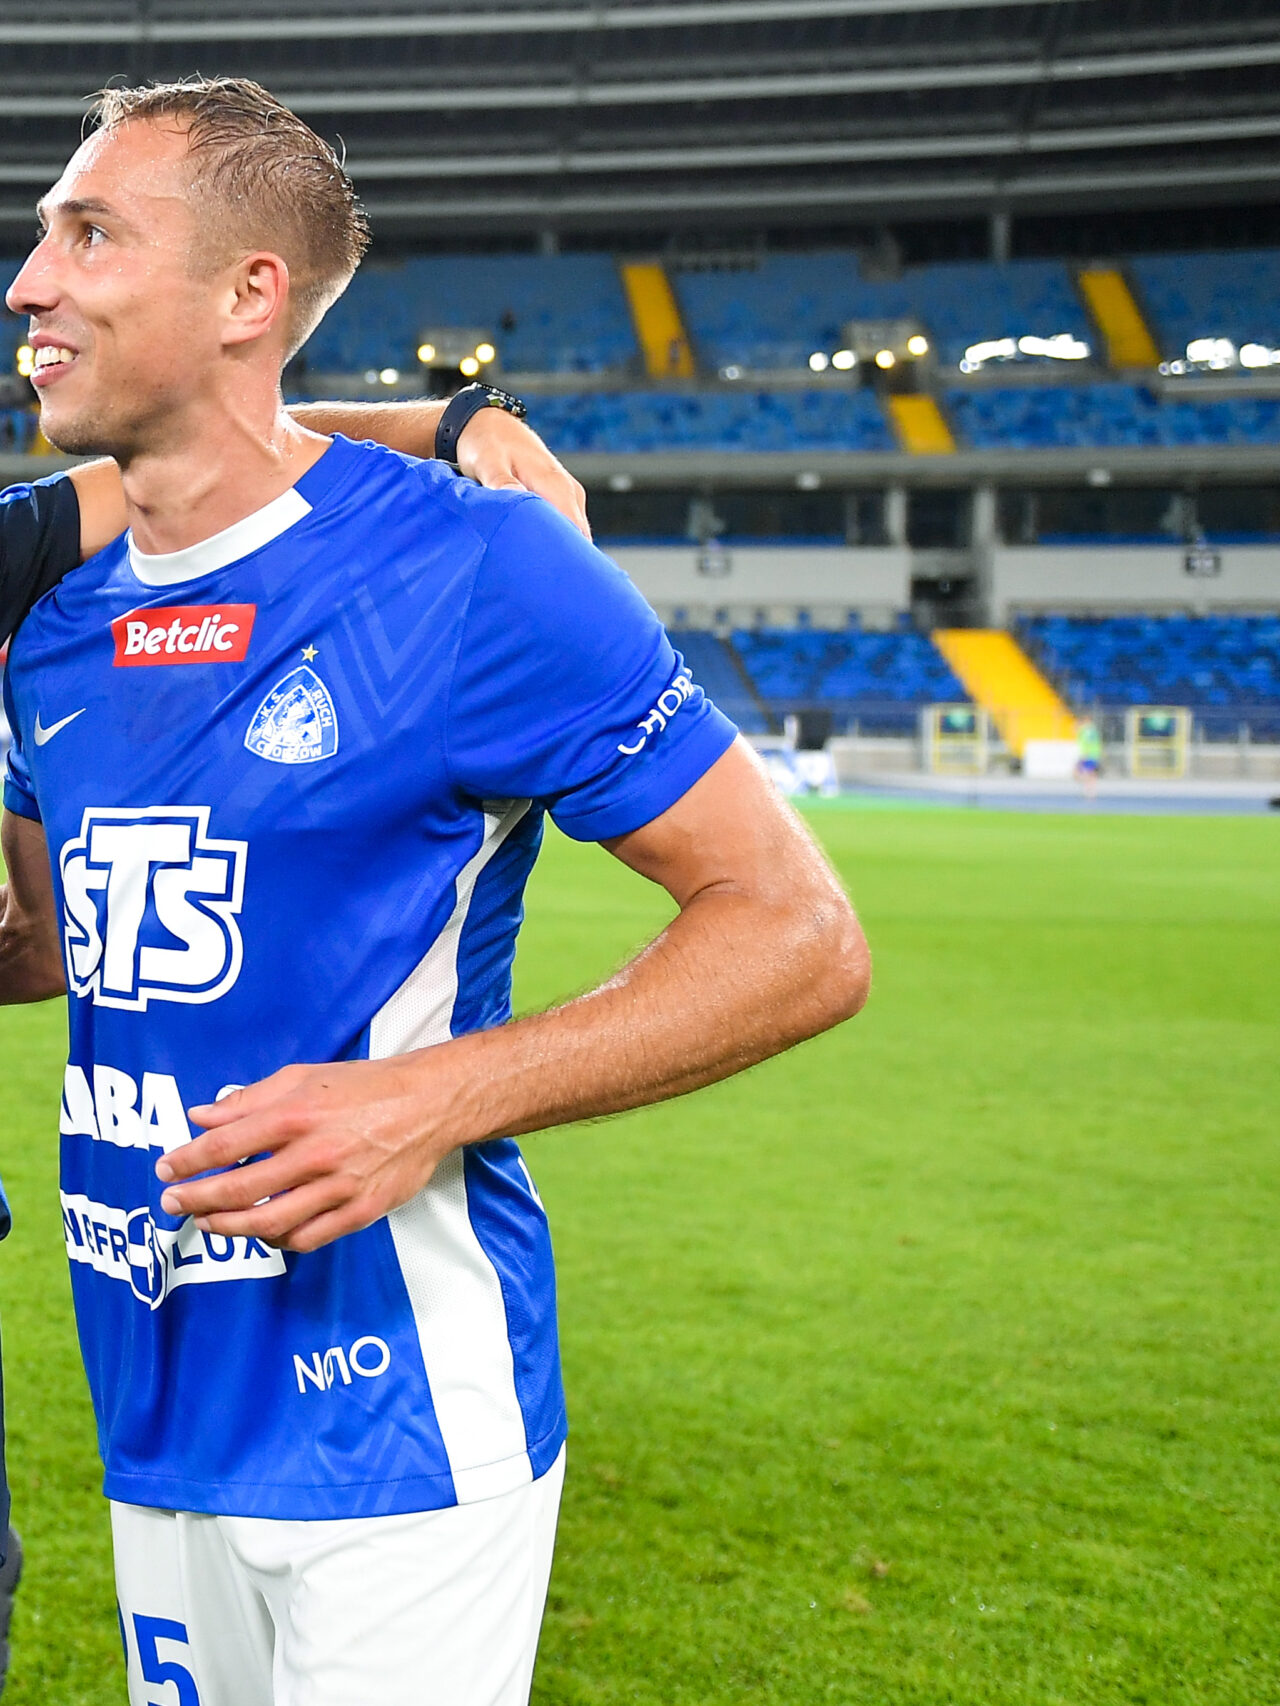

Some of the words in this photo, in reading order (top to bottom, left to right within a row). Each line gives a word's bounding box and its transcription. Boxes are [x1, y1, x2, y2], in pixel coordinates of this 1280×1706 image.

[123, 613, 240, 655] Betclic
[311, 688, 333, 727] RUCH
[617, 667, 694, 755] CHOR
[59, 805, 248, 1013] STS
[59, 1063, 193, 1156] LBA
